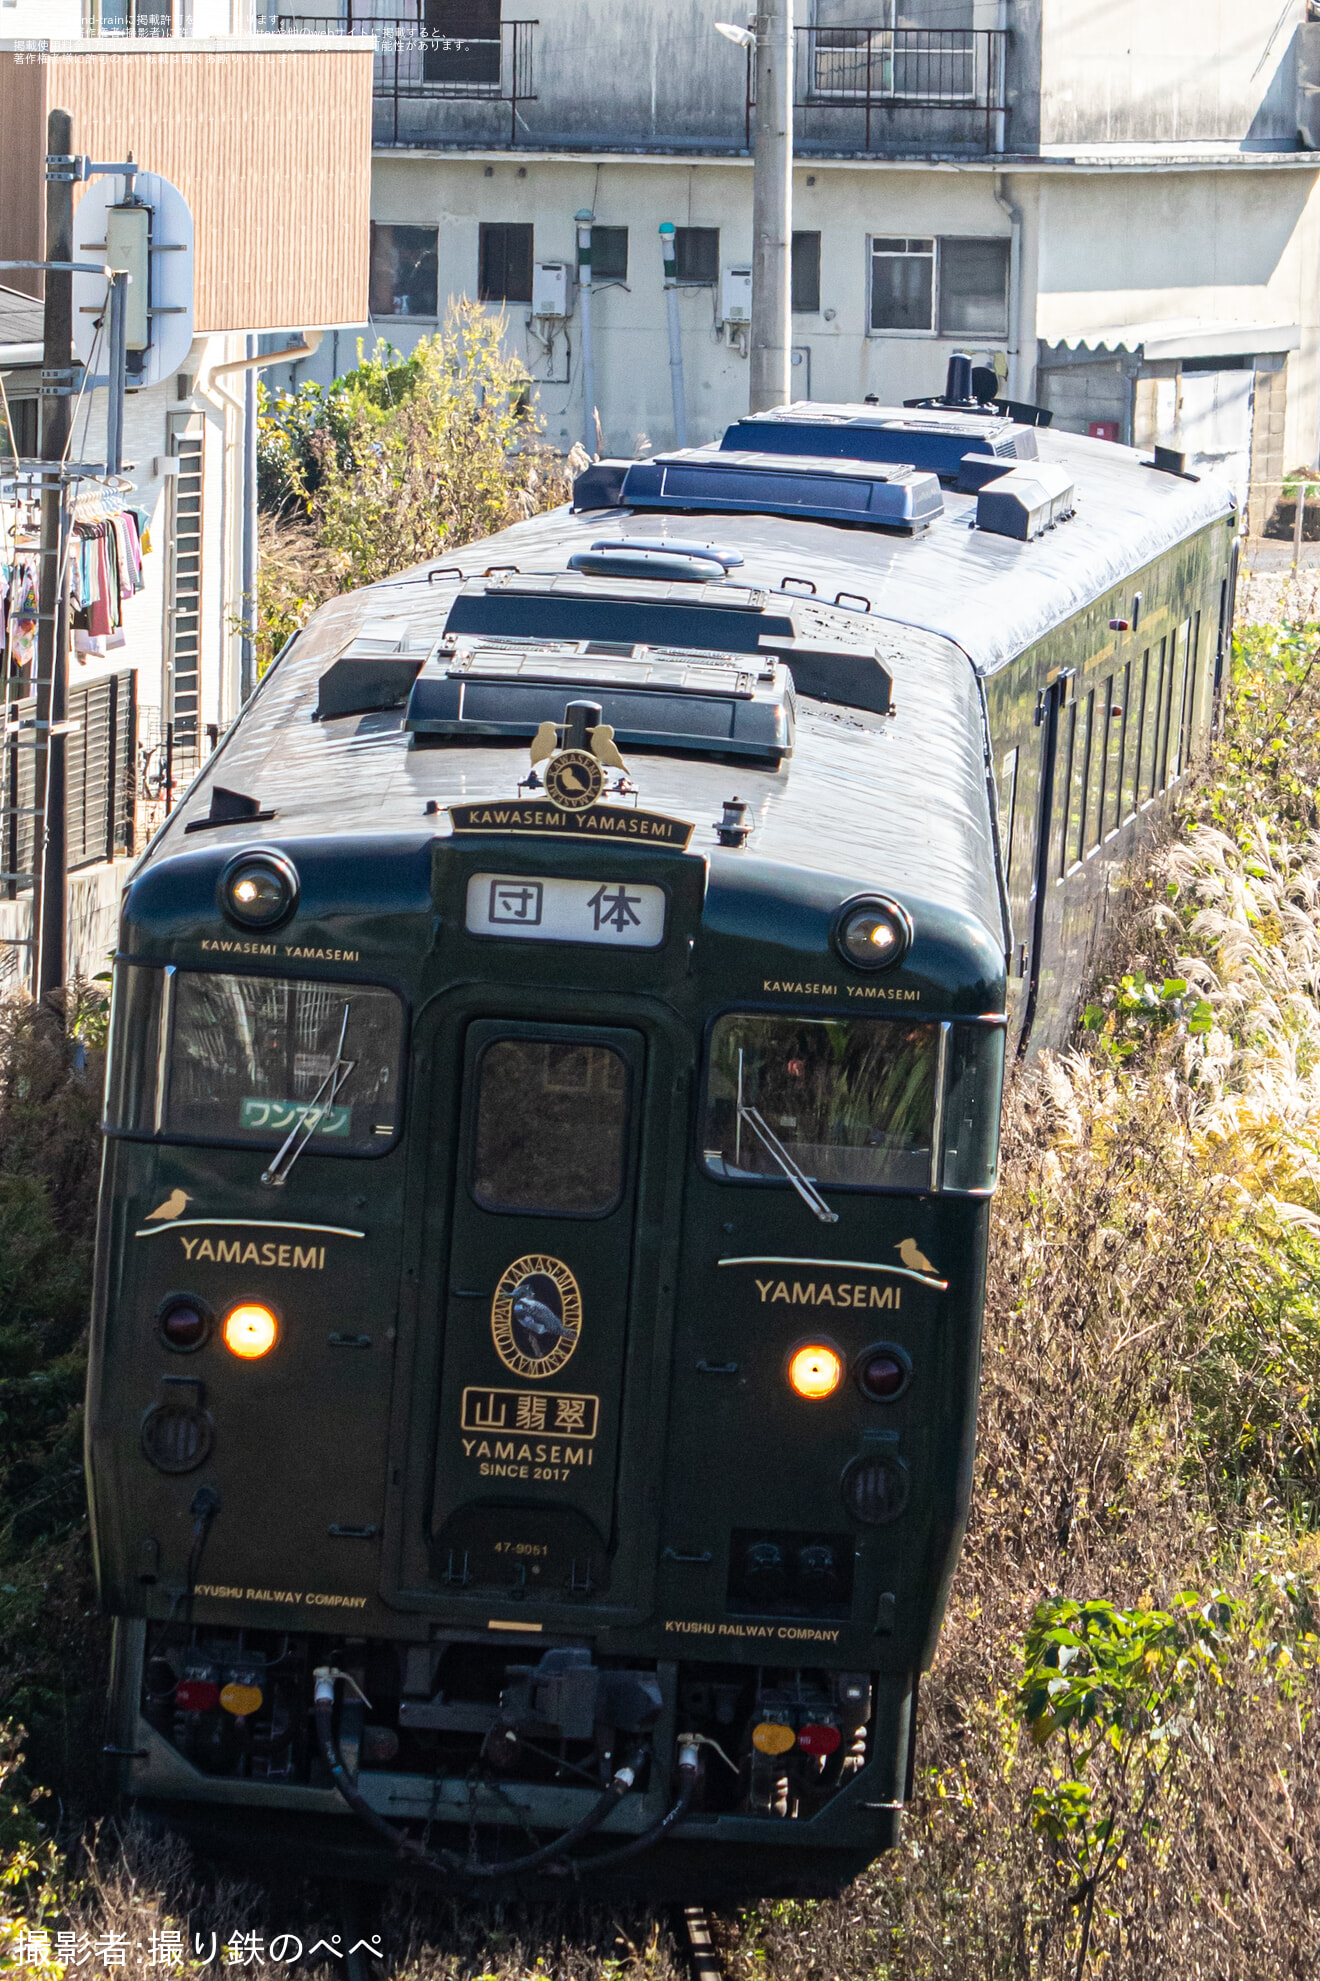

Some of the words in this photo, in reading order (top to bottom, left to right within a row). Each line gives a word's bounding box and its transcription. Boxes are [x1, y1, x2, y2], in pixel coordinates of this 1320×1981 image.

[469, 810, 567, 826] KAWASEMI
[576, 814, 673, 837] YAMASEMI
[488, 879, 642, 933] 団体
[201, 940, 277, 955] KAWASEMI
[285, 946, 359, 961] YAMASEMI
[763, 980, 838, 995] KAWASEMI
[846, 986, 921, 1001] YAMASEMI
[245, 1102, 347, 1133] ワンマン
[180, 1237, 326, 1270] YAMASEMI
[502, 1257, 577, 1291] YAMASEMI
[755, 1279, 901, 1310] YAMASEMI
[561, 1294, 580, 1348] KYUSU
[508, 1347, 569, 1376] RAILWAY
[475, 1393, 586, 1433] 山翡翠
[462, 1438, 593, 1465] YAMASEMI
[479, 1462, 529, 1478] SINCE
[533, 1467, 570, 1481] 2017
[194, 1584, 243, 1598] KYUSHU
[246, 1588, 302, 1603] RAILWAY
[305, 1593, 367, 1608] COMPANY
[665, 1620, 716, 1634] KYUSHU
[718, 1624, 774, 1637] RAILWAY
[777, 1627, 839, 1641] COMPANY
